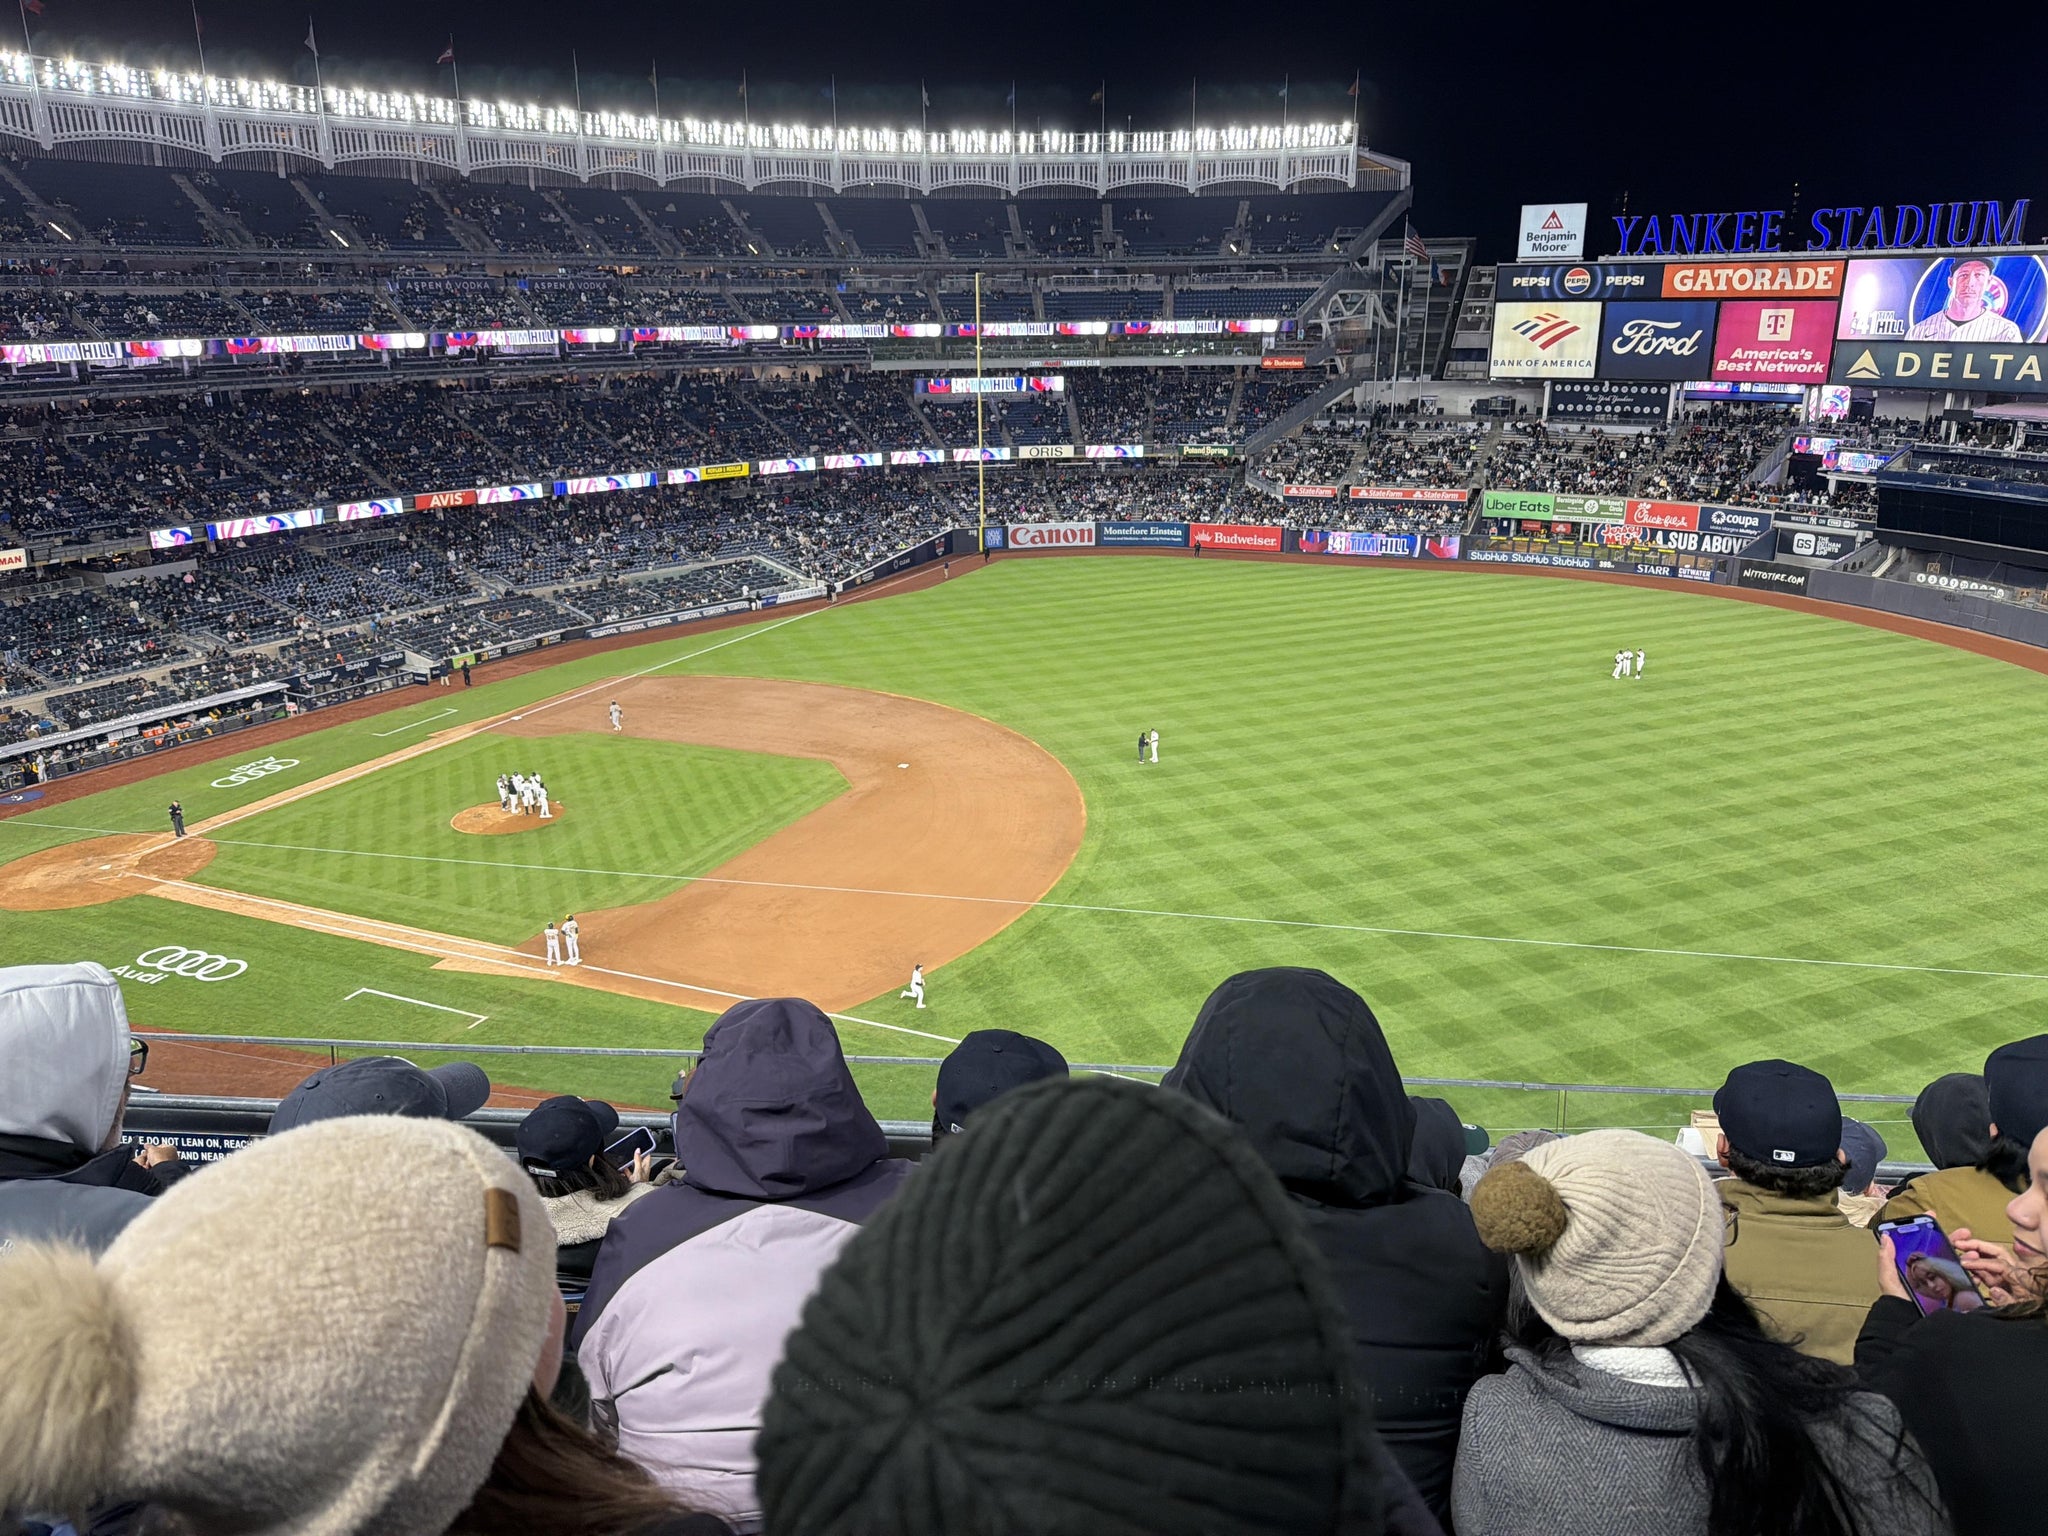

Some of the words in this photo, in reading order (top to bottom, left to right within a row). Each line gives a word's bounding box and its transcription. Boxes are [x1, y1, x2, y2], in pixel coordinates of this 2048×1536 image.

[1612, 210, 1785, 256] YANKEE
[1807, 199, 2029, 250] STADIUM
[1526, 231, 1577, 244] Benjamin
[1531, 243, 1568, 252] Moore
[406, 281, 441, 290] ASPEN
[455, 281, 490, 290] VODKA
[534, 281, 565, 290] ASPEN
[577, 281, 608, 289] VODKA
[1512, 277, 1550, 287] PEPSI
[1566, 277, 1590, 285] PEPSI
[1605, 276, 1645, 287] PEPSI
[1673, 266, 1834, 292] GATORADE
[863, 325, 884, 337] HILL
[1028, 324, 1049, 336] HILL
[1196, 320, 1218, 333] HILL
[1876, 320, 1904, 334] HILL
[530, 330, 554, 344] HILL
[701, 327, 722, 340] HILL
[1611, 319, 1703, 356] Ford
[320, 335, 349, 350] HILL
[49, 343, 80, 360] TIM
[81, 342, 115, 359] HILL
[1730, 347, 1813, 361] America's
[1274, 359, 1303, 367] Budweiser
[1493, 359, 1522, 367] BANK
[1525, 359, 1539, 367] OF
[1541, 360, 1592, 368] AMERICA
[1716, 359, 1752, 372] Best
[1754, 360, 1825, 374] Network
[1896, 352, 2043, 382] DELTA
[993, 377, 1017, 392] HILL
[1029, 446, 1063, 457] ORIS
[1183, 446, 1205, 455] Poland
[1206, 446, 1228, 456] Spring
[430, 494, 463, 507] AVIS
[1486, 499, 1517, 511] Uber
[1519, 500, 1550, 513] Eats
[1634, 506, 1688, 527] Chick-fil-A
[1726, 514, 1759, 528] coupa
[1010, 526, 1093, 546] Canon
[1103, 526, 1148, 535] Montefiore
[1150, 526, 1182, 536] Einstein
[1601, 523, 1642, 536] Jersey
[1350, 537, 1376, 553] TIM
[1378, 537, 1409, 554] HILL
[1668, 531, 1698, 551] SUB
[1796, 538, 1811, 549] GS
[1470, 552, 1508, 562] StubHub
[1511, 553, 1549, 564] StubHub
[1552, 557, 1590, 568] StubHub
[1637, 563, 1670, 575] STARR
[1678, 567, 1711, 576] CUTWATER
[1743, 568, 1805, 585] NITTOTIRE.COM
[380, 652, 403, 663] StubHub
[345, 661, 369, 672] StubHub
[306, 670, 332, 681] StubHub
[108, 965, 169, 984] Audi
[146, 1136, 159, 1146] DO
[161, 1137, 179, 1147] NOT
[181, 1137, 203, 1148] LEAN
[206, 1138, 222, 1149] ON,
[177, 1150, 198, 1160] TAND
